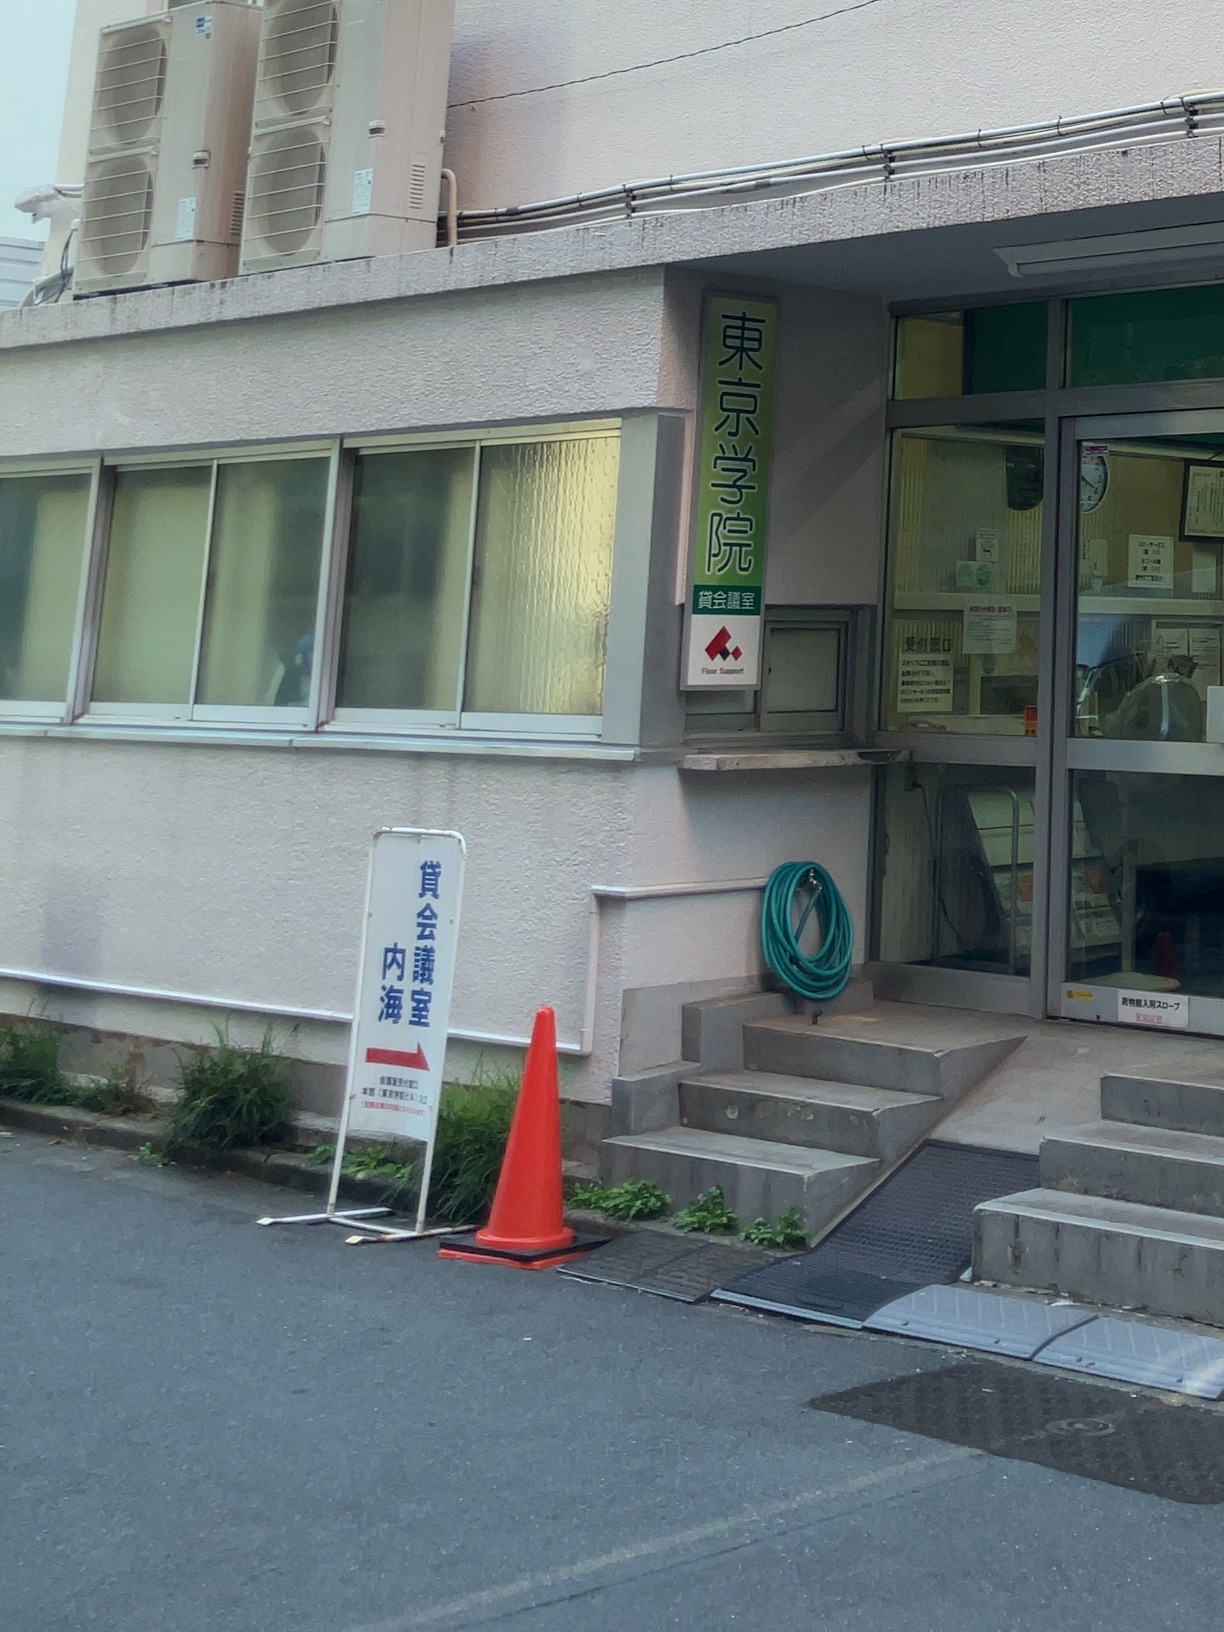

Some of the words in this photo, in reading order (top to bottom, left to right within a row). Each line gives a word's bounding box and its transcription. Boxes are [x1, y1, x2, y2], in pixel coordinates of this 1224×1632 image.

[706, 311, 767, 575] 東京学院
[698, 590, 755, 610] 貸会議室
[719, 667, 744, 675] Support
[378, 942, 406, 1025] 内海
[408, 860, 442, 1028] 貸会議室
